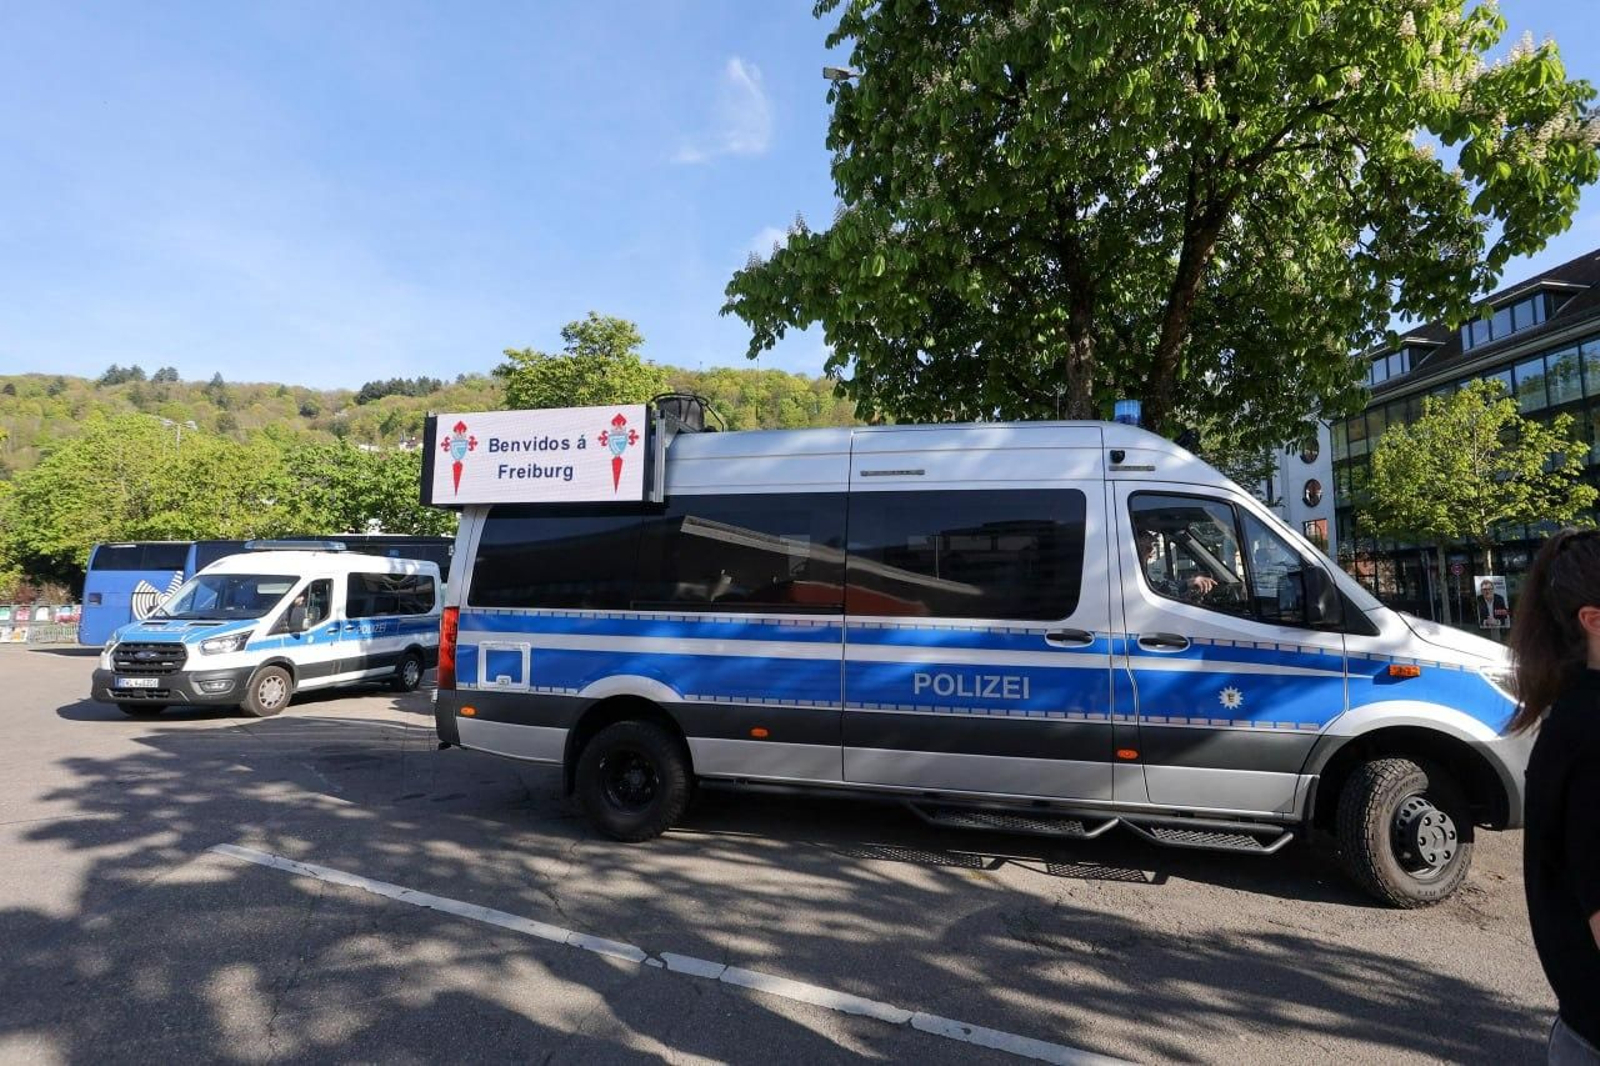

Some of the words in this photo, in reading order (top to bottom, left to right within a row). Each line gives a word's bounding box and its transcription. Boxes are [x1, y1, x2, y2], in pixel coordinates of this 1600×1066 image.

[489, 436, 570, 453] Benvidos
[577, 434, 586, 450] á
[498, 463, 573, 481] Freiburg
[914, 673, 1030, 699] POLIZEI
